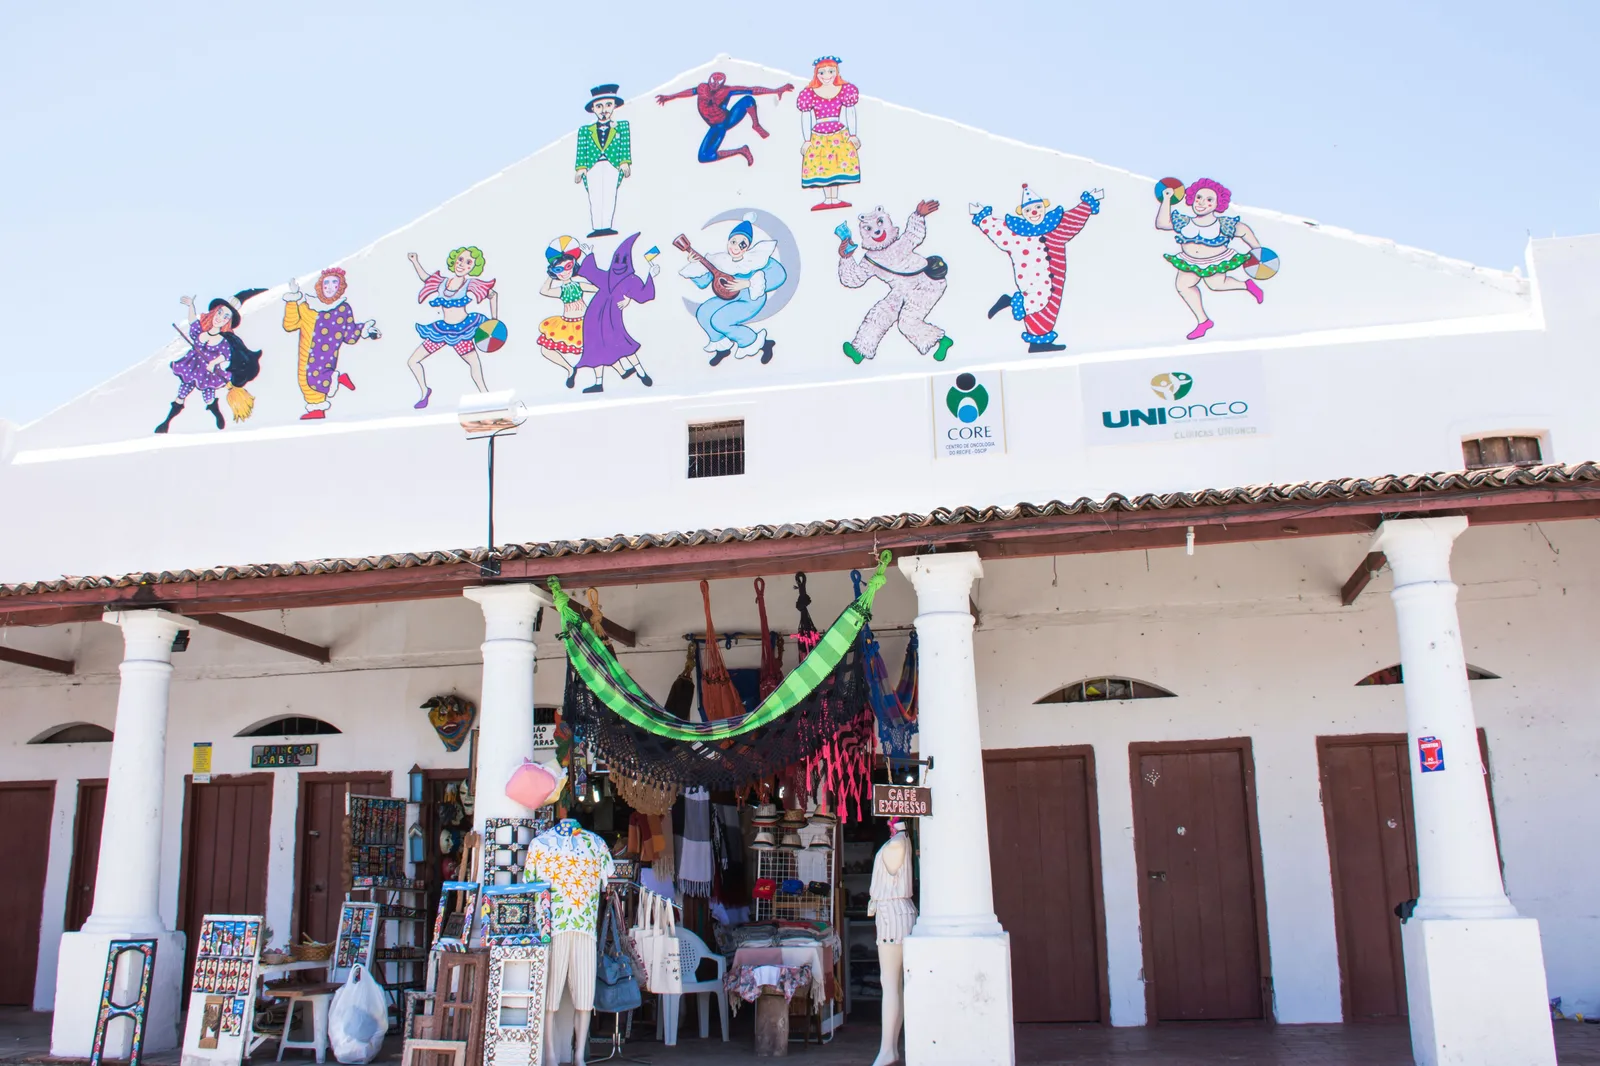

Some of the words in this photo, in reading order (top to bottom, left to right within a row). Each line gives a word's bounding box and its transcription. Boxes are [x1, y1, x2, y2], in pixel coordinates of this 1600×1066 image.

[947, 426, 992, 440] CORE
[263, 745, 312, 755] PRINCESA
[256, 755, 300, 765] ISABEL
[888, 788, 917, 801] CAFÉ
[878, 800, 927, 814] EXPRESSO
